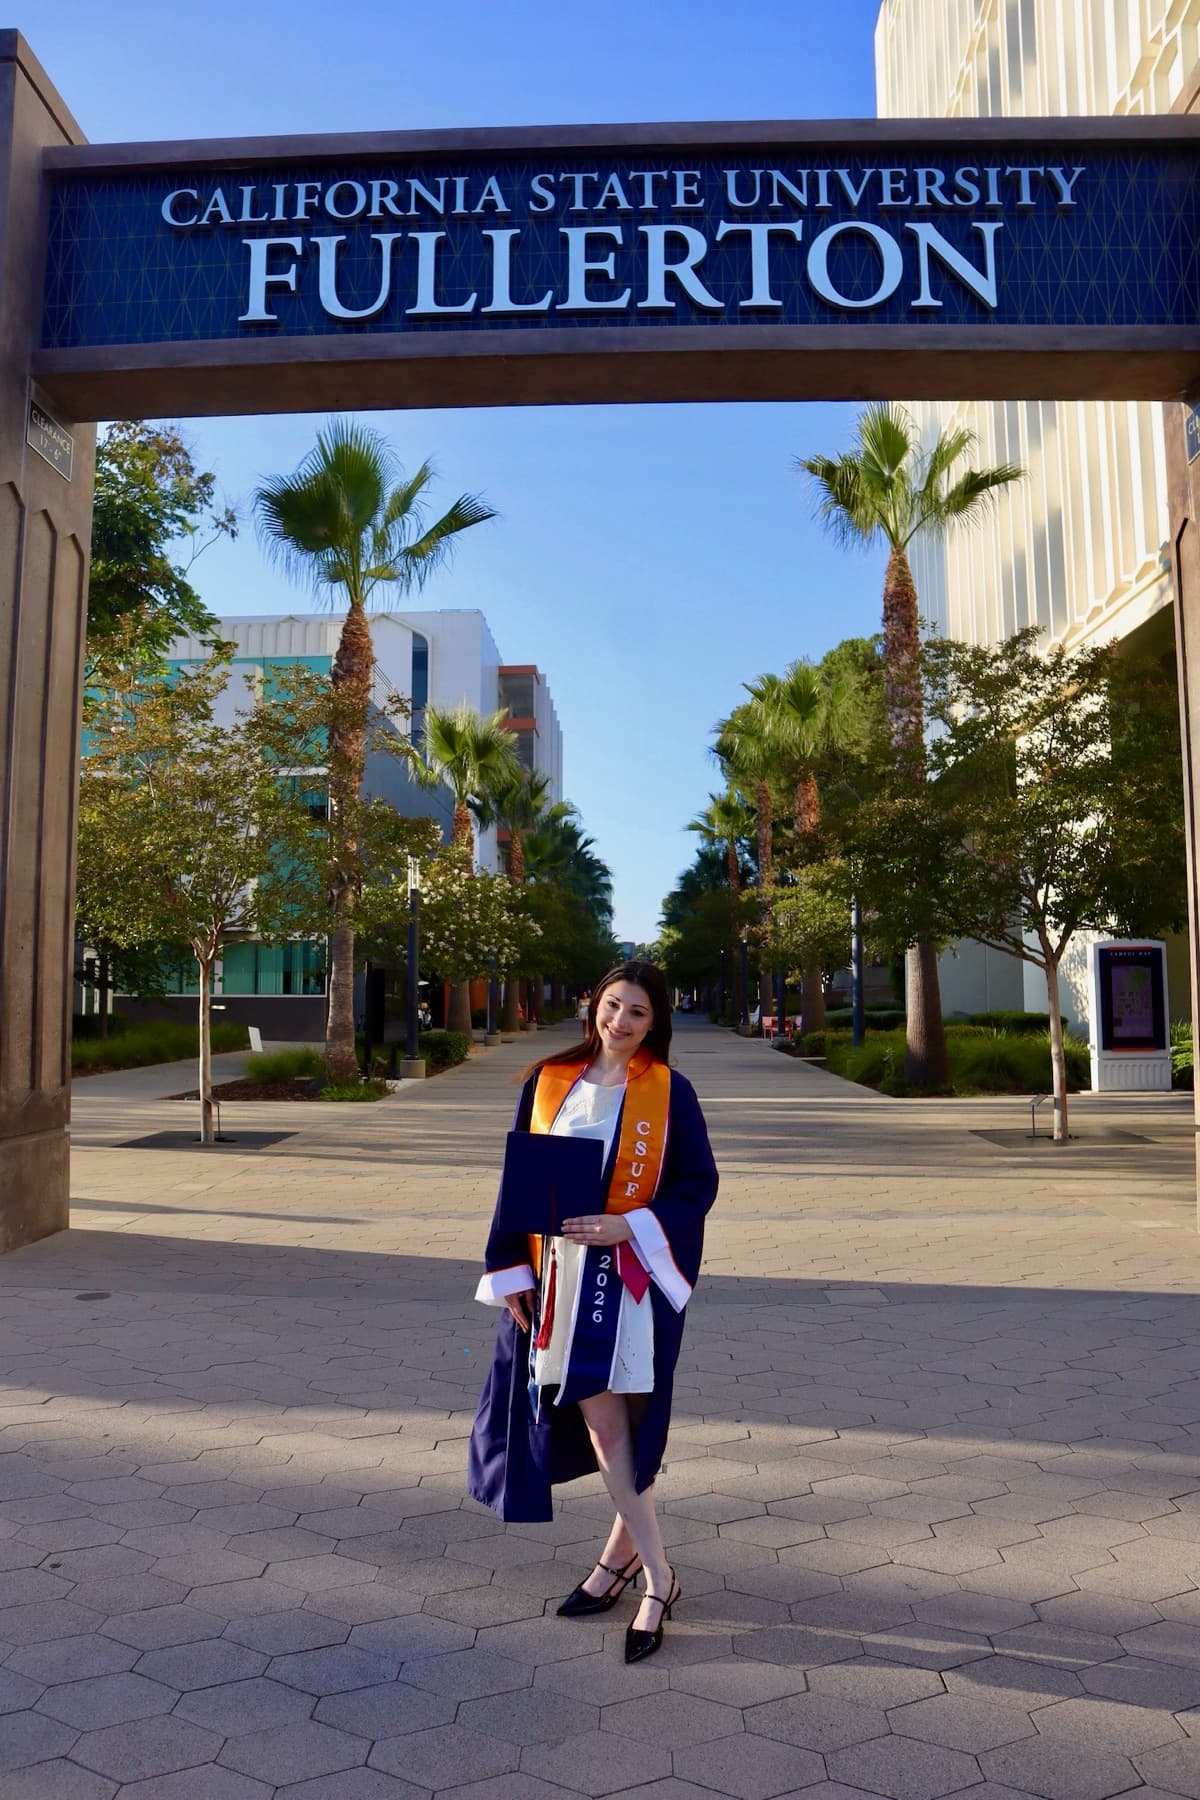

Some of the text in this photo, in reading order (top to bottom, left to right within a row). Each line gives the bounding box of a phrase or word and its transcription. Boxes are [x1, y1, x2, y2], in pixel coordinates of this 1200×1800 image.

[161, 165, 1086, 226] CALIFORNIA STATE UNIVERSITY
[238, 219, 1004, 321] FULLERTON
[31, 409, 71, 455] CLEARANCE
[592, 1255, 612, 1323] 2026
